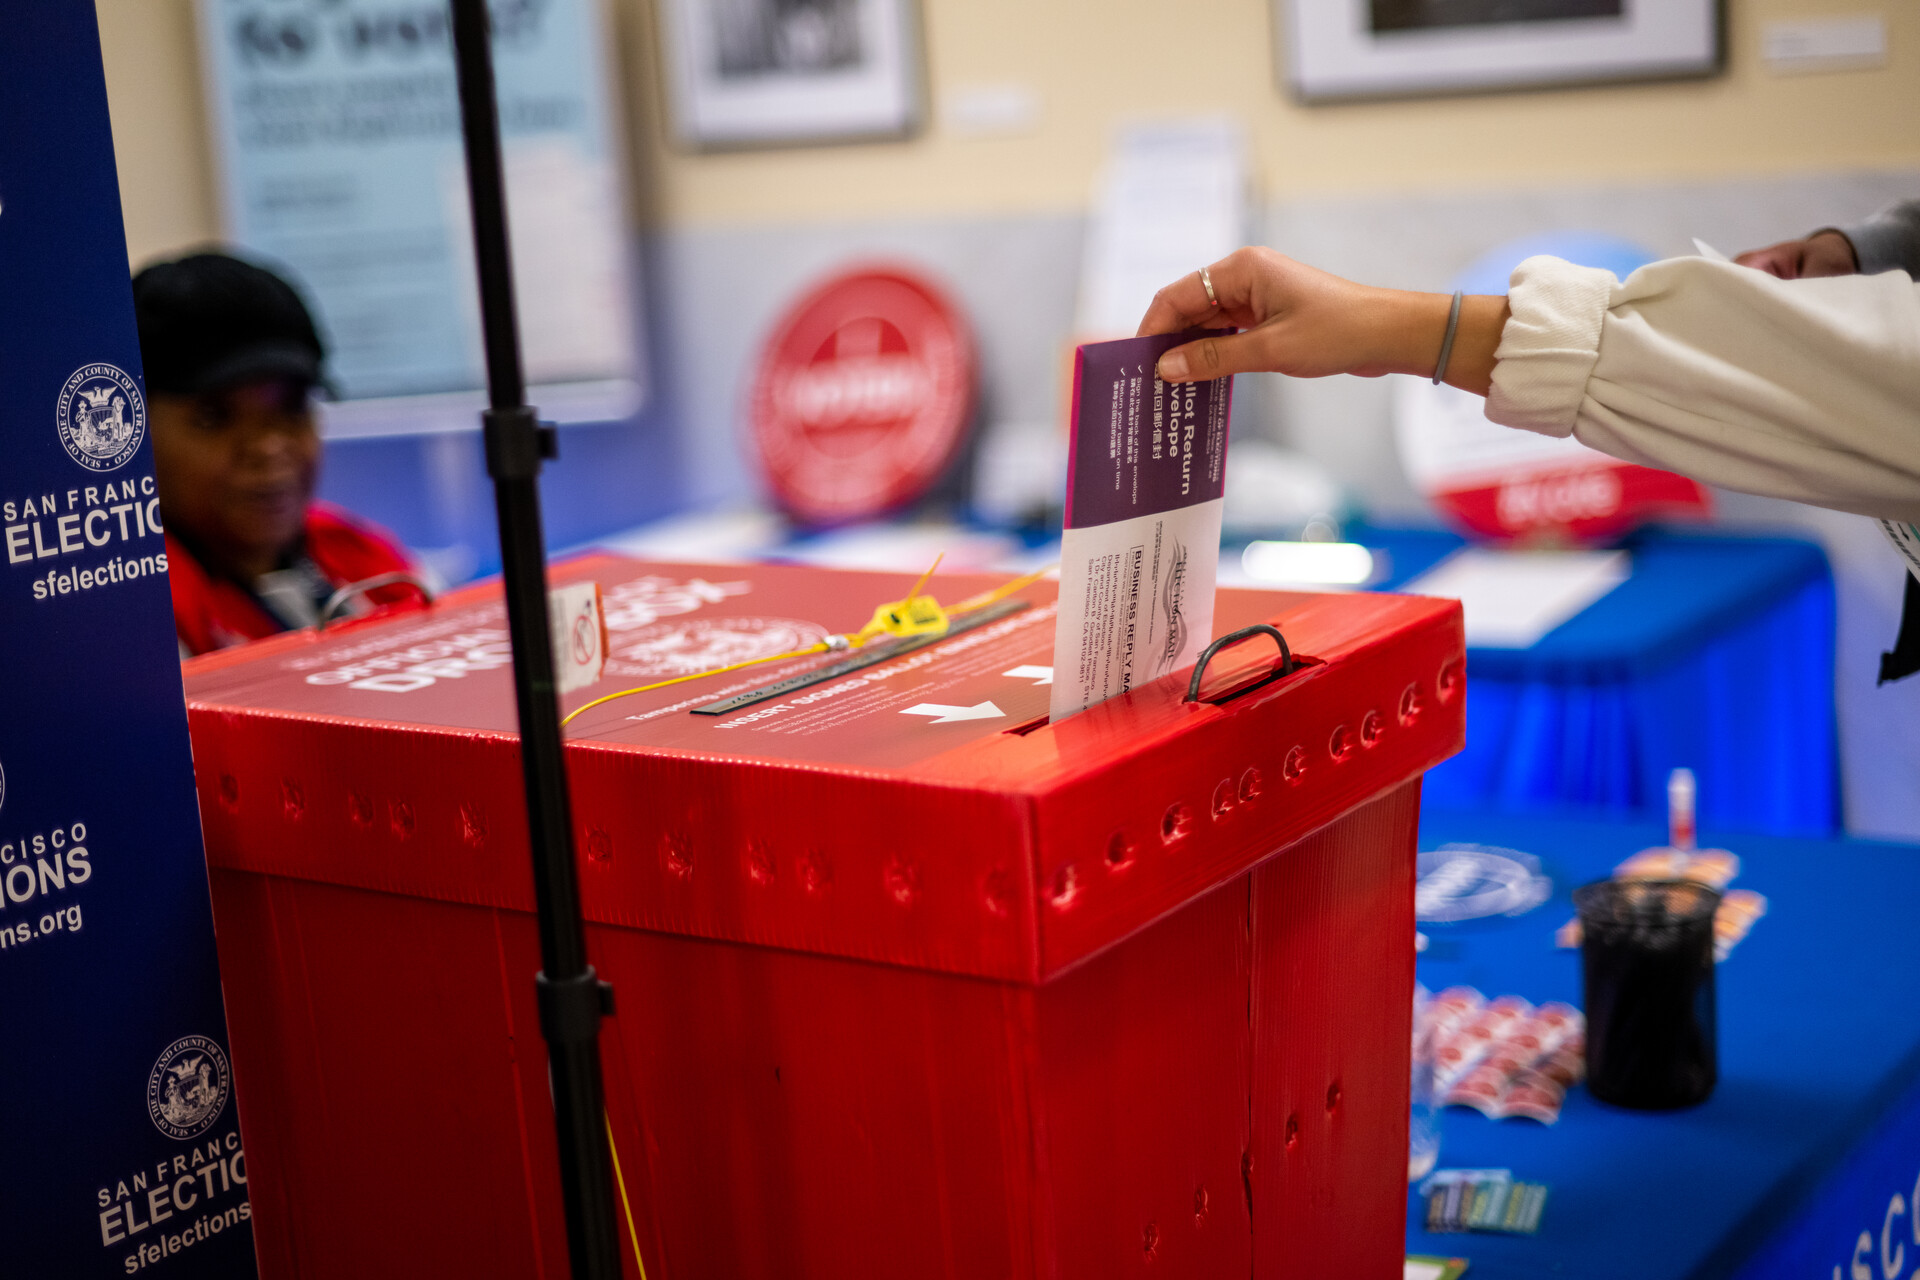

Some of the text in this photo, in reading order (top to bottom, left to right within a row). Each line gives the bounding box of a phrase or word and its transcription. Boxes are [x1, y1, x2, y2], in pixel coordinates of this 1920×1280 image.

[60, 367, 142, 468] SEAL OF THE CITY AND COUNTY OF SAN FRANCISCO
[1182, 425, 1195, 495] Return
[4, 476, 155, 521] SAN FRANC
[5, 497, 164, 564] ELECTIO
[32, 553, 169, 600] sfelections
[1129, 550, 1142, 620] BUSINESS
[1171, 562, 1182, 624] ELECTION
[1083, 622, 1089, 634] CA
[1125, 624, 1134, 668] REPLY
[1168, 629, 1176, 660] MAIL
[626, 694, 720, 721] Tampering
[713, 704, 795, 729] INSERT
[790, 678, 870, 705] SIGNED
[0, 822, 86, 864] CISCO
[0, 904, 82, 949] ns.org
[158, 1051, 173, 1070] AND
[174, 1038, 206, 1052] COUNTY
[208, 1044, 218, 1054] OF
[151, 1073, 159, 1096] CITY
[151, 1098, 160, 1118] THE
[158, 1119, 168, 1129] OF
[170, 1126, 188, 1136] SEAL
[98, 1132, 238, 1207] SAN FRANC
[99, 1150, 248, 1247] ELECTIO
[124, 1201, 252, 1274] sfelections
